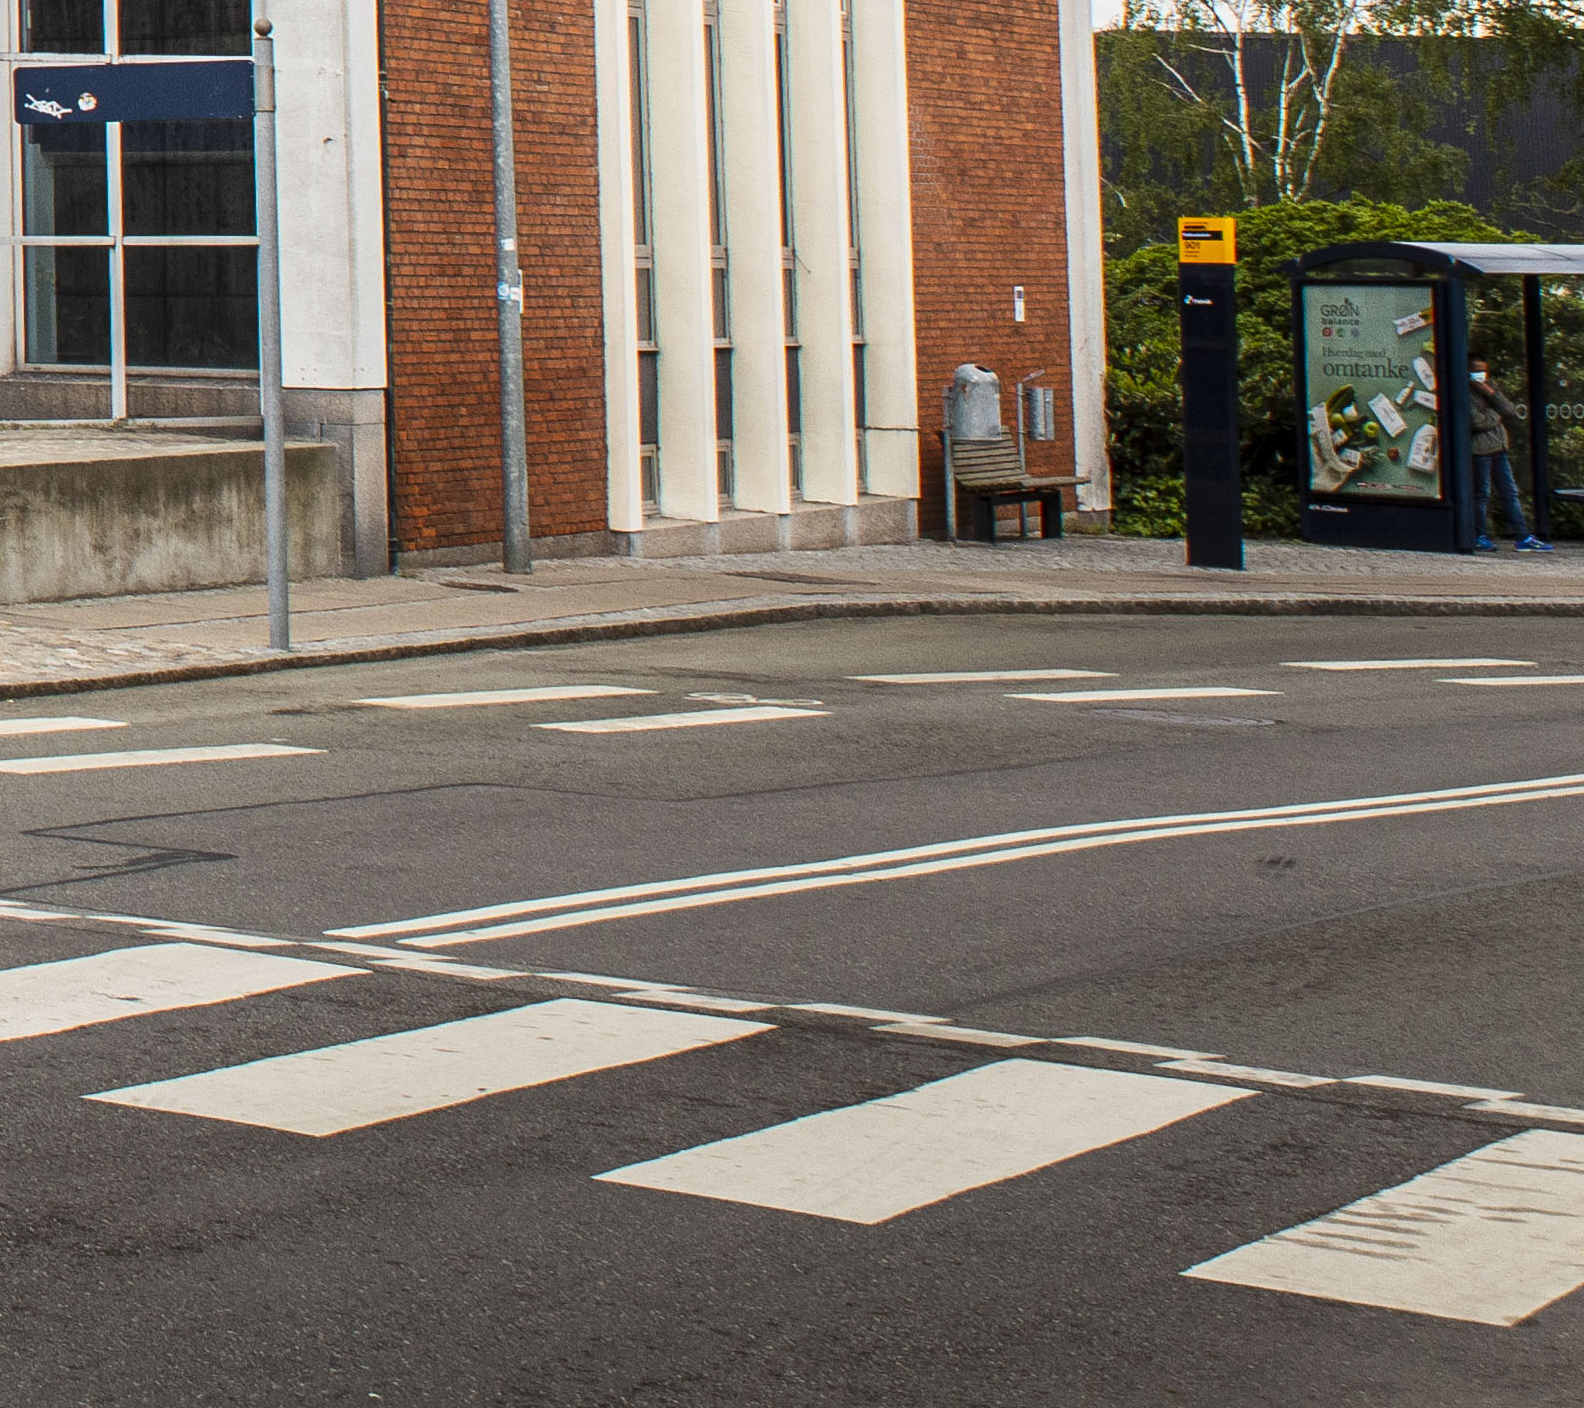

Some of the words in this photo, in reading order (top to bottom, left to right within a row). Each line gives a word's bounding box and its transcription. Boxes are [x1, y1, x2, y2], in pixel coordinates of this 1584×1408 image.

[1322, 317, 1359, 325] balance
[1366, 349, 1387, 358] med
[1322, 358, 1408, 378] omtanke
